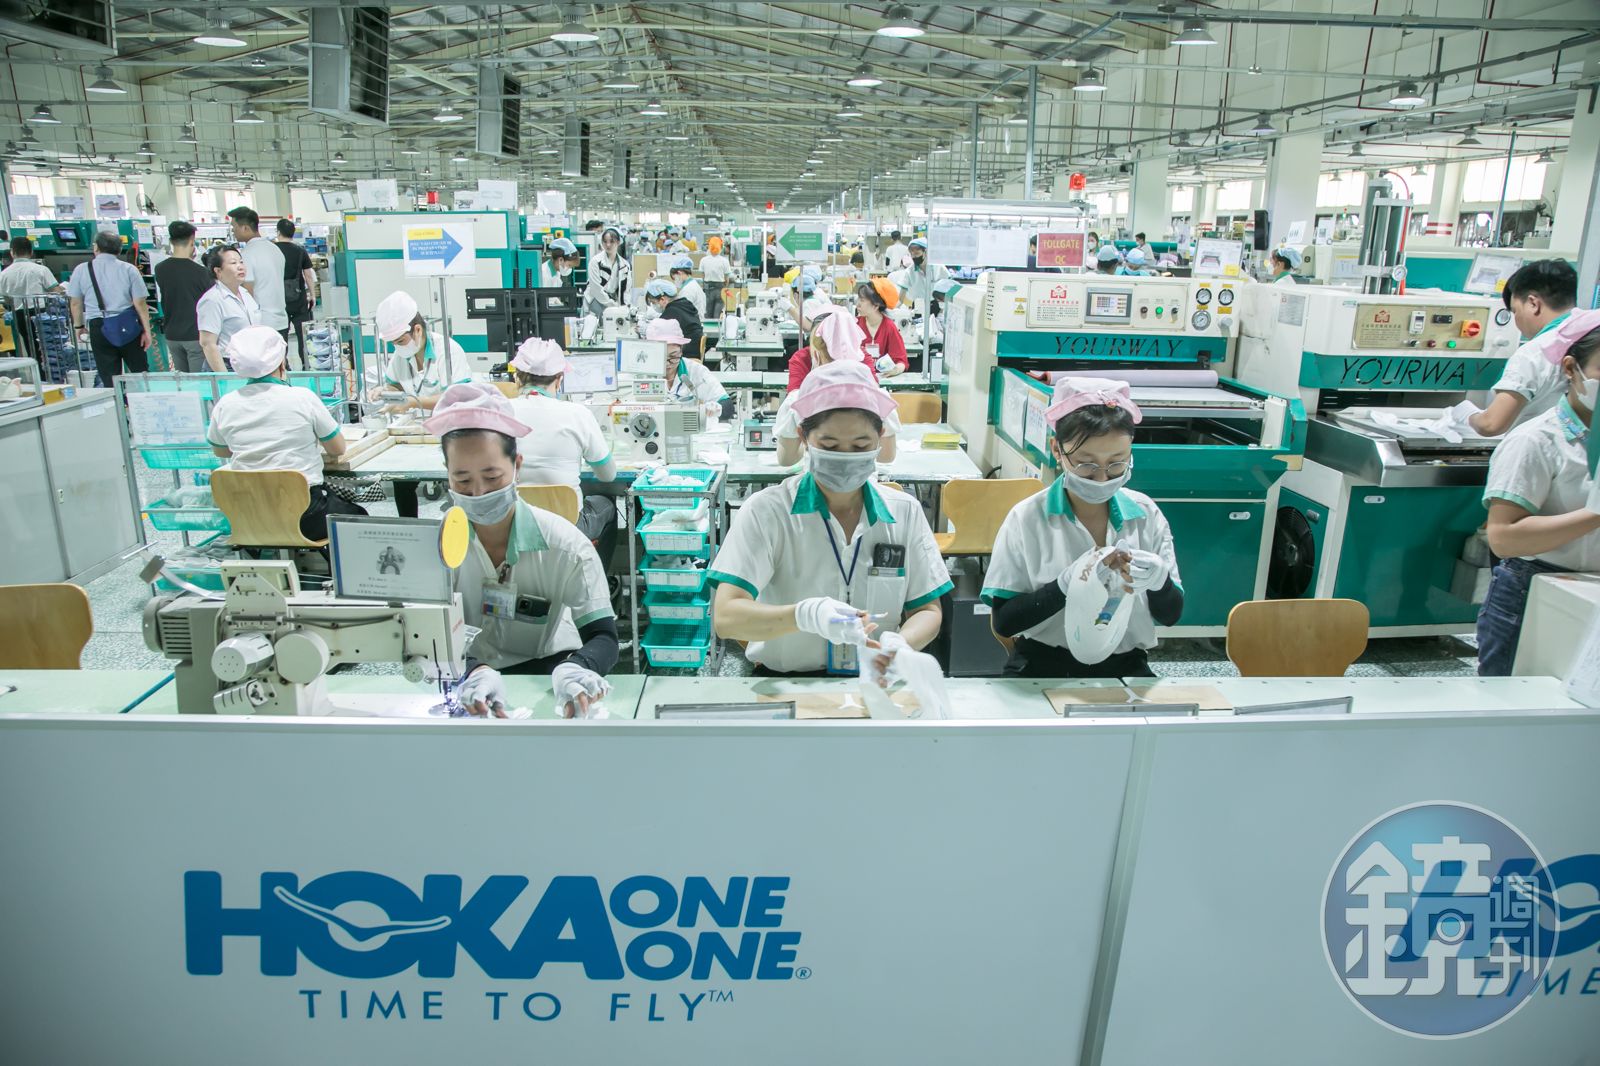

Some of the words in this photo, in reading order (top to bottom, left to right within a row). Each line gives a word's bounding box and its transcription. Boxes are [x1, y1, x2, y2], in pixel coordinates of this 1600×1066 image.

[1042, 239, 1080, 249] TOLLGATE
[1055, 255, 1066, 266] QC
[1055, 336, 1183, 357] YOURWAY
[1340, 358, 1492, 386] YOURWAY
[184, 870, 625, 980] HOKA
[609, 875, 790, 929] ONE
[299, 990, 443, 1020] TIME
[485, 991, 562, 1022] TO
